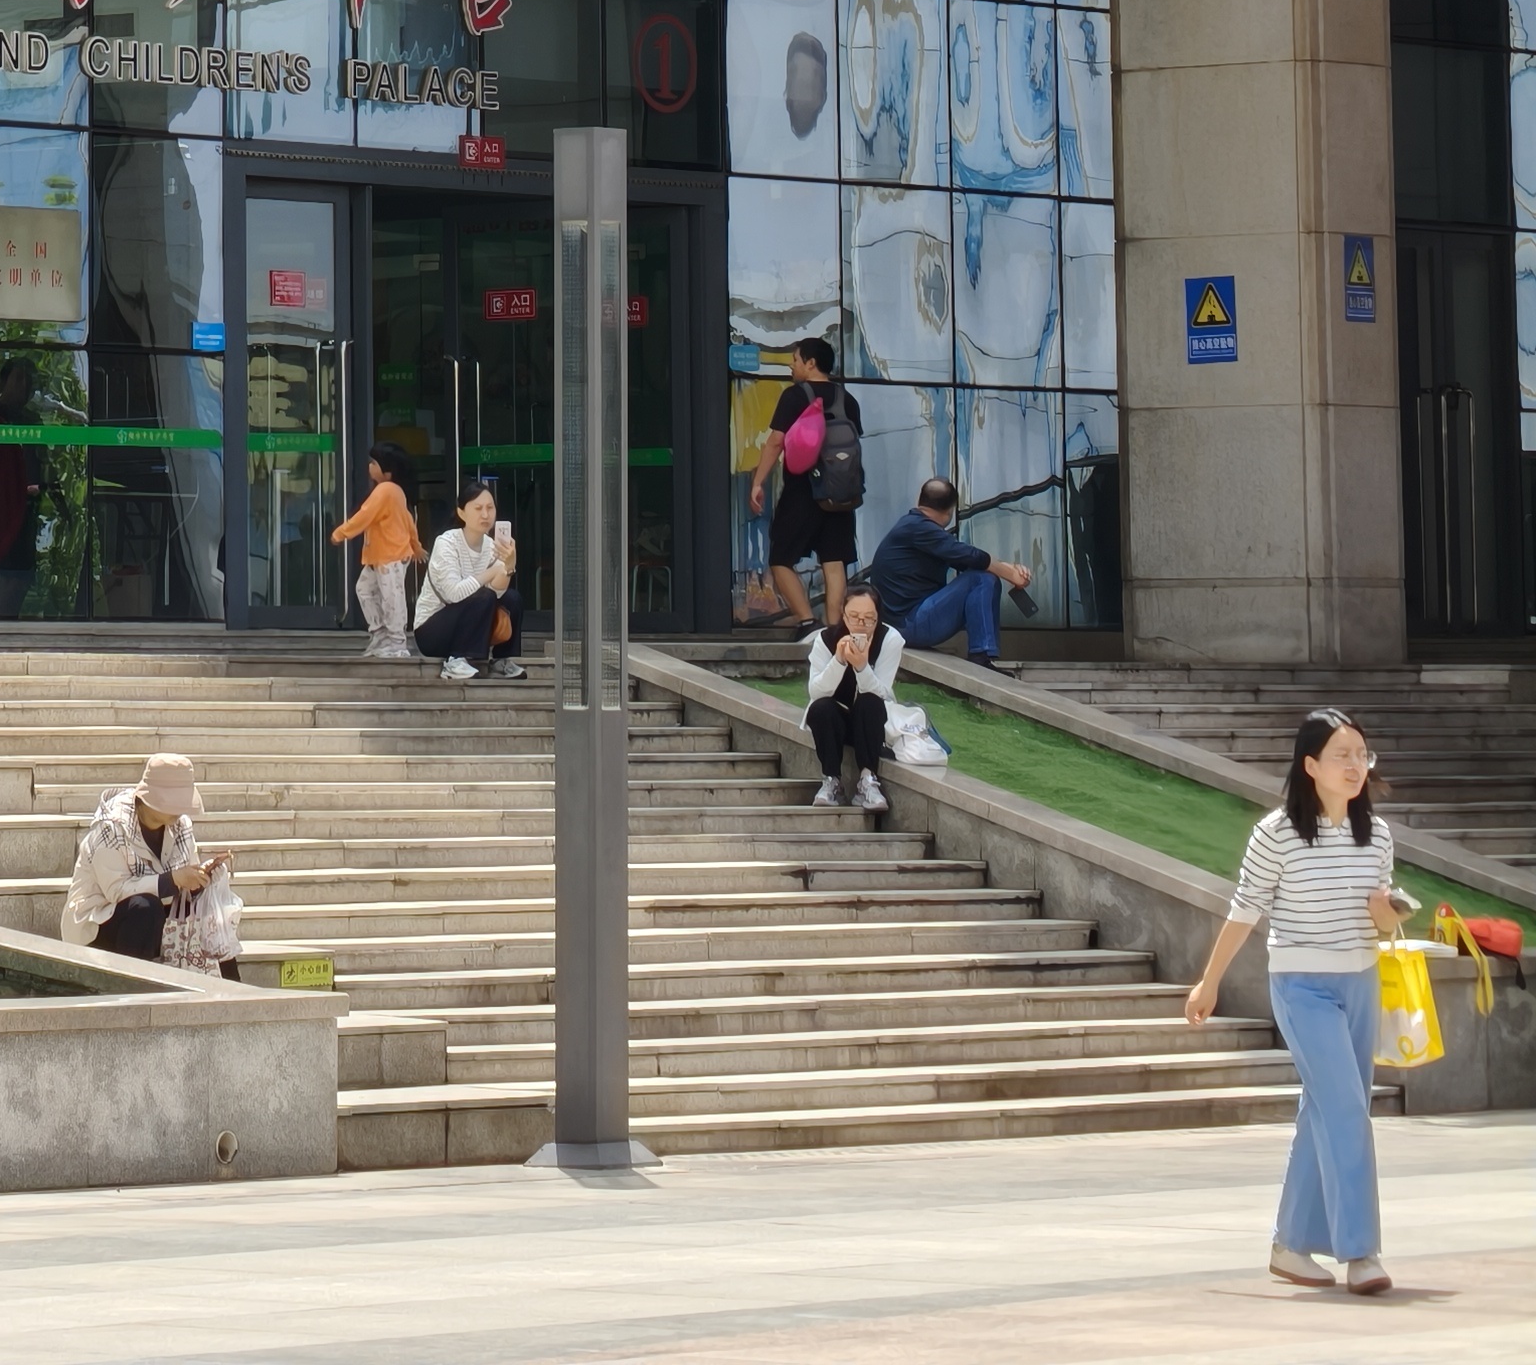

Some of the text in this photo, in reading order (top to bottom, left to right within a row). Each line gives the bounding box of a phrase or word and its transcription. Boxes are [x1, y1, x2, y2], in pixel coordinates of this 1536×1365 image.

[81, 35, 312, 94] CHILDREN'S
[345, 58, 500, 110] PALACE
[484, 141, 498, 153] 入口
[511, 294, 530, 307] 入口
[510, 307, 530, 315] ENTER
